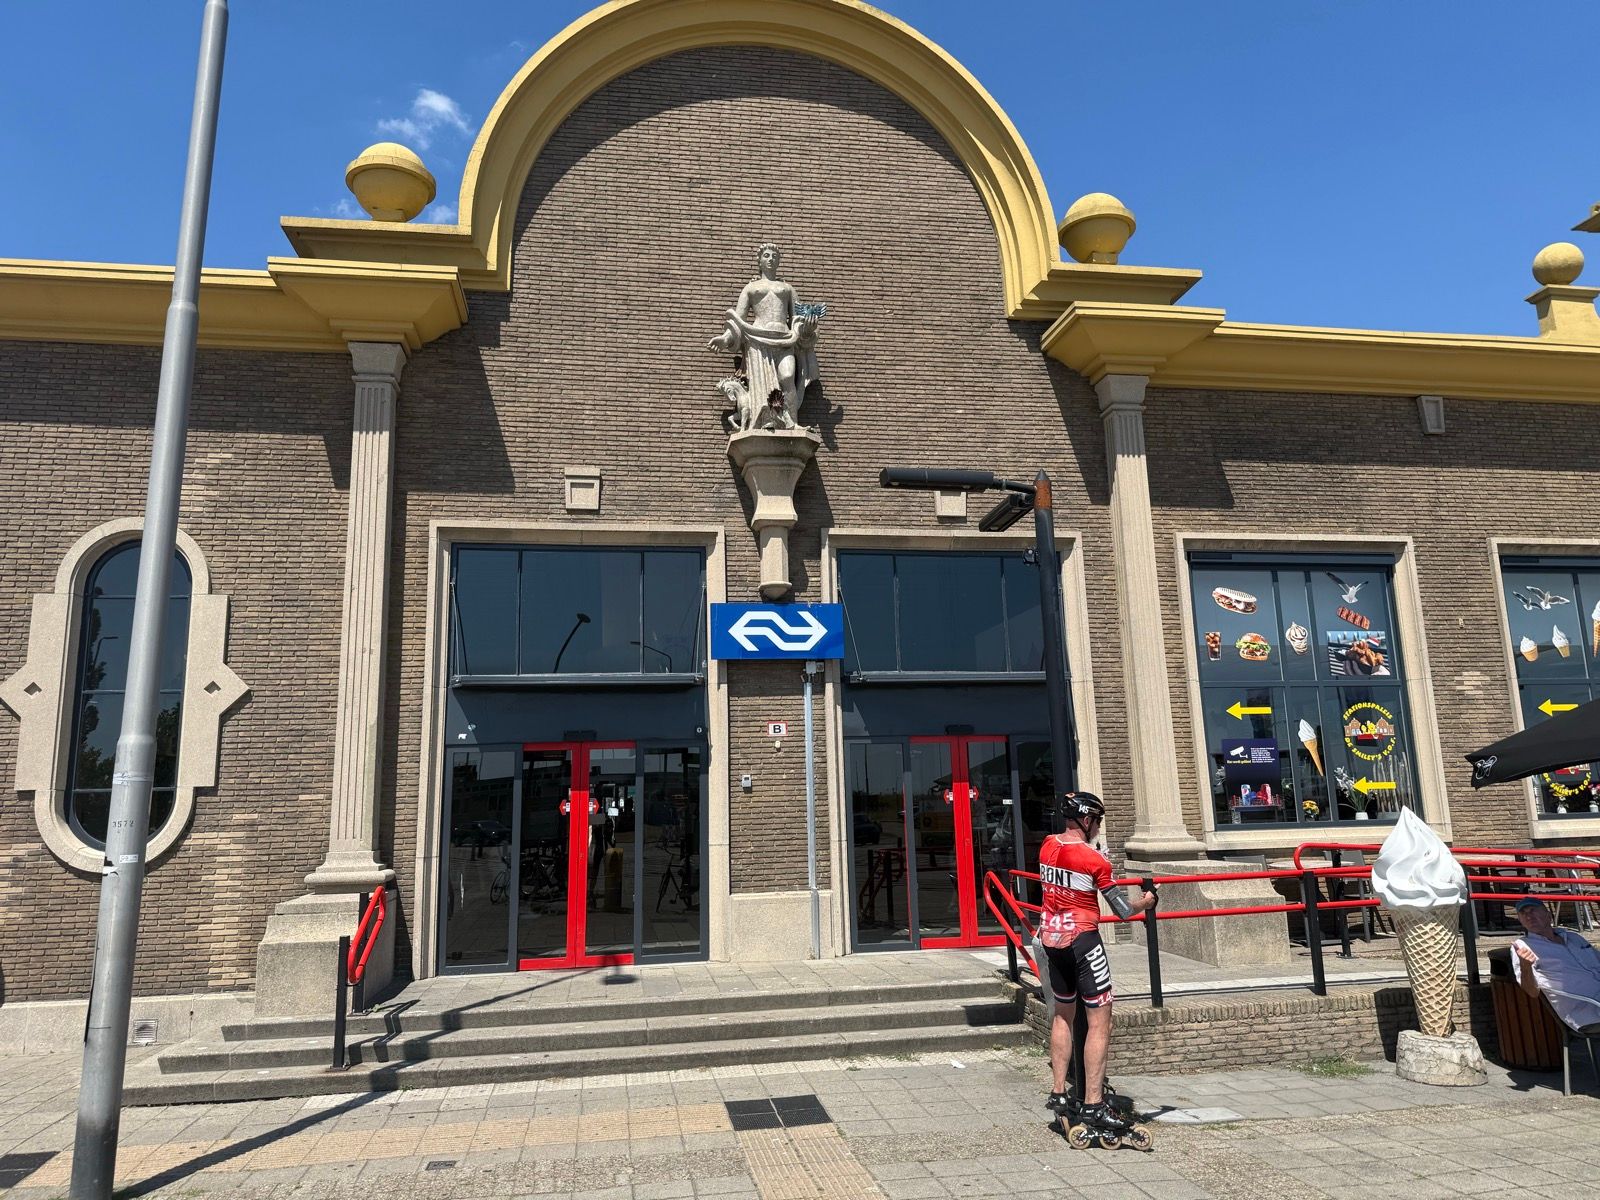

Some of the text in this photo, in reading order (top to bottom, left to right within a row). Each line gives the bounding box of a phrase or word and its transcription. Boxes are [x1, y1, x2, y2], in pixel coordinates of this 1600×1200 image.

[773, 725, 781, 733] B
[1078, 804, 1090, 814] 145
[1040, 865, 1073, 888] BONT
[1040, 911, 1076, 932] 145
[1085, 944, 1112, 991] BONT
